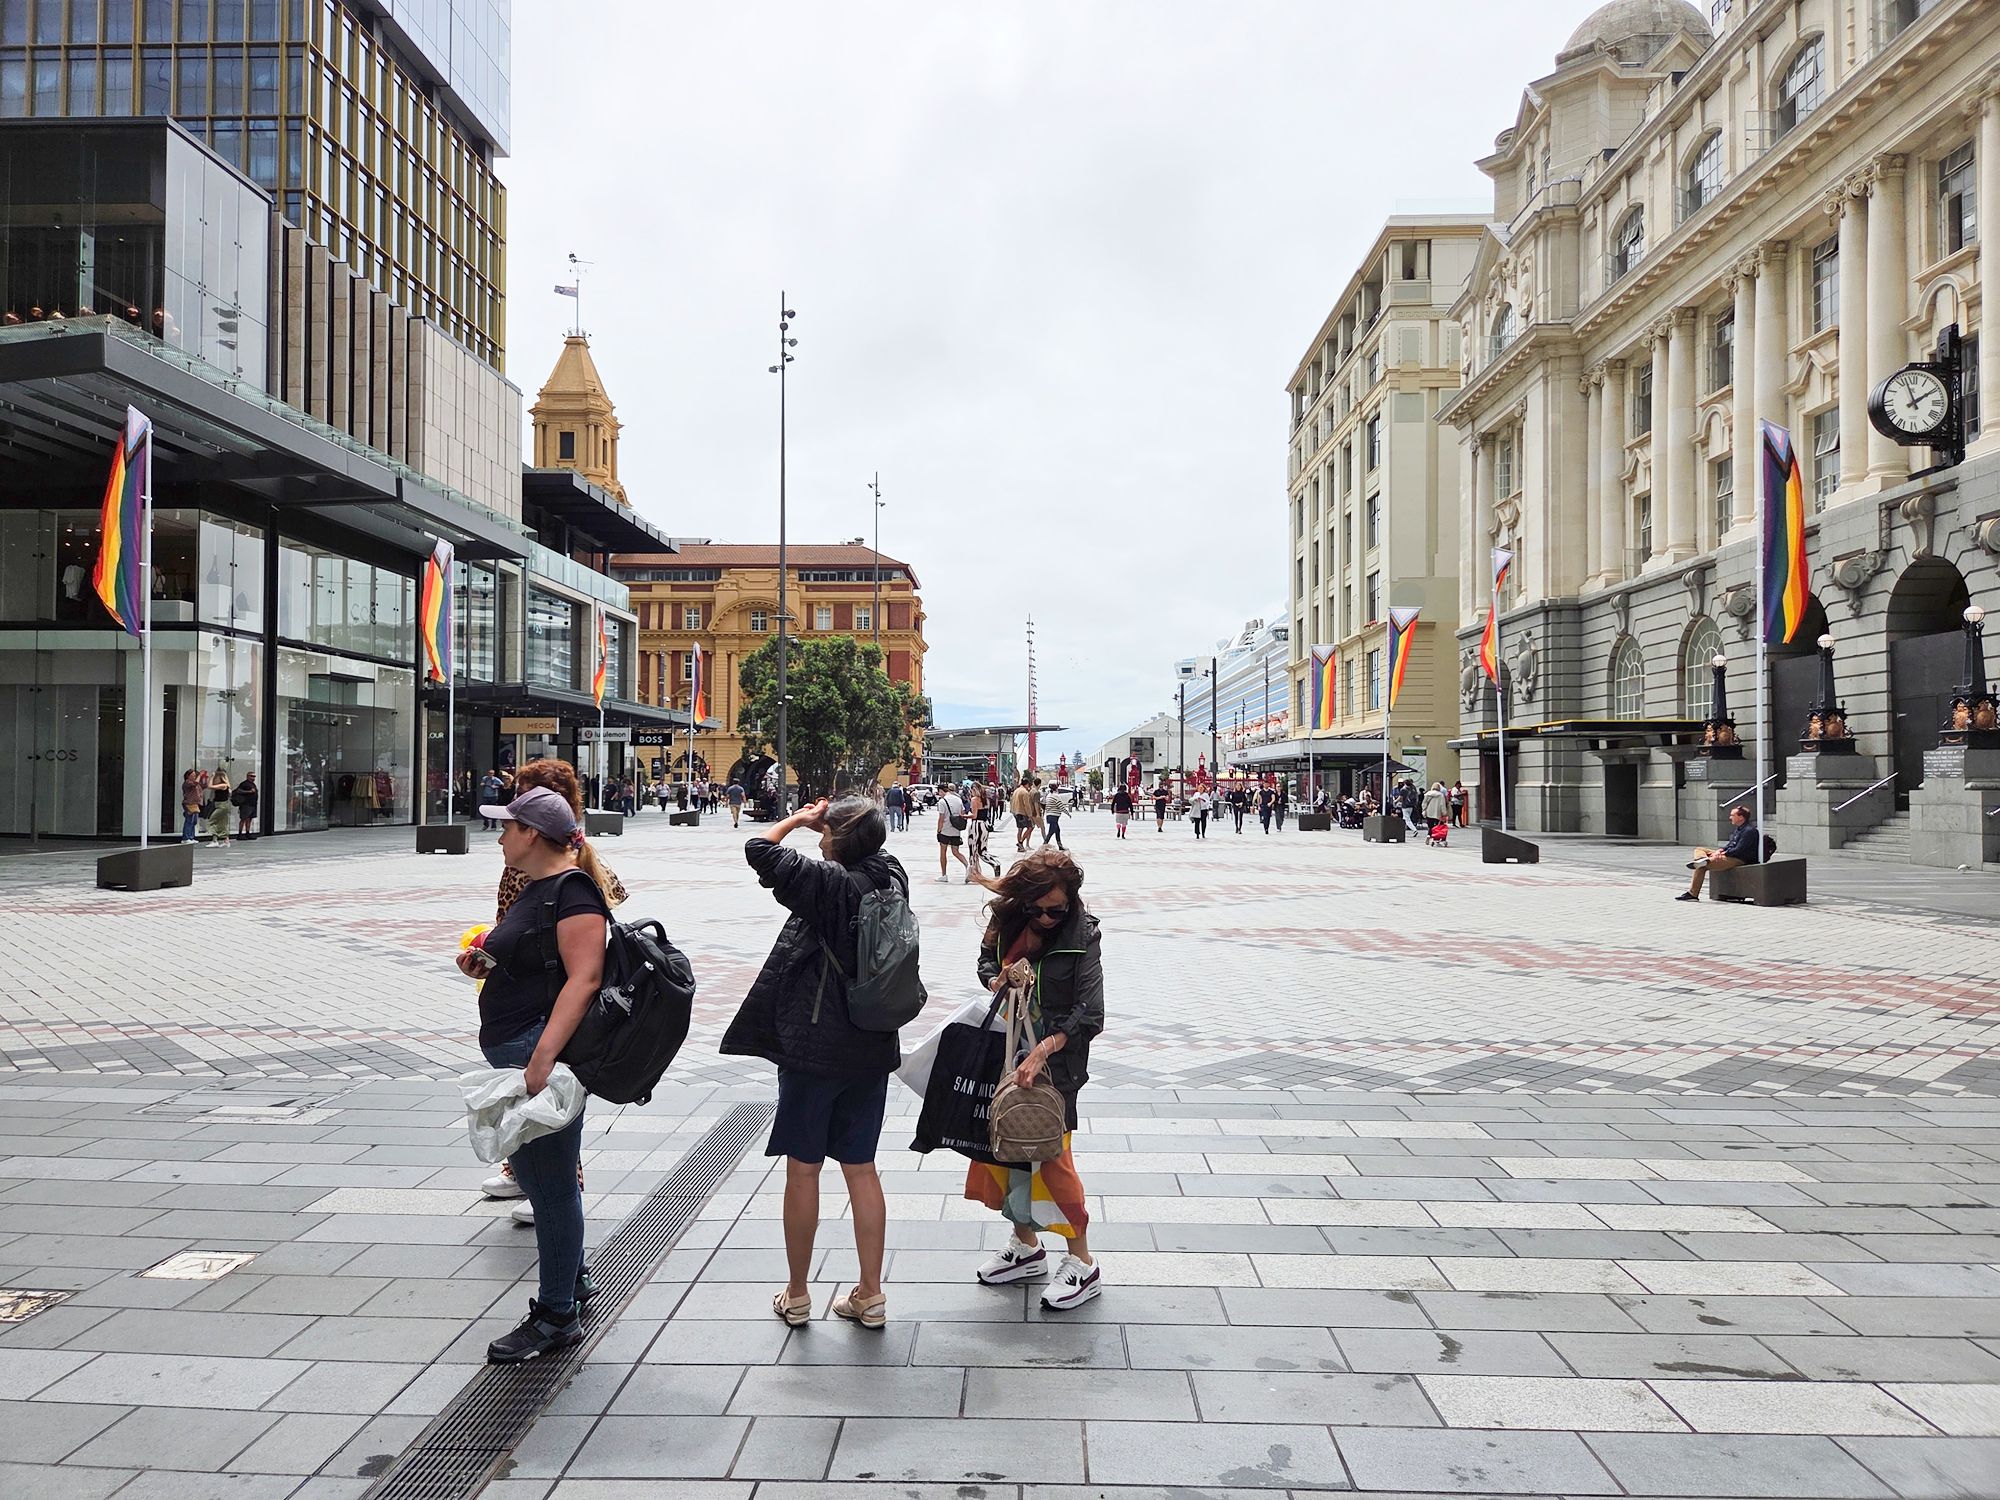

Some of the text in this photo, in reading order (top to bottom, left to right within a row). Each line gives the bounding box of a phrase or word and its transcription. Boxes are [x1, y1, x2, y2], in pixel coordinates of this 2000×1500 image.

[527, 722, 556, 730] MECCA
[638, 735, 664, 744] BOSS
[44, 749, 78, 761] COS
[953, 1075, 976, 1096] SAN
